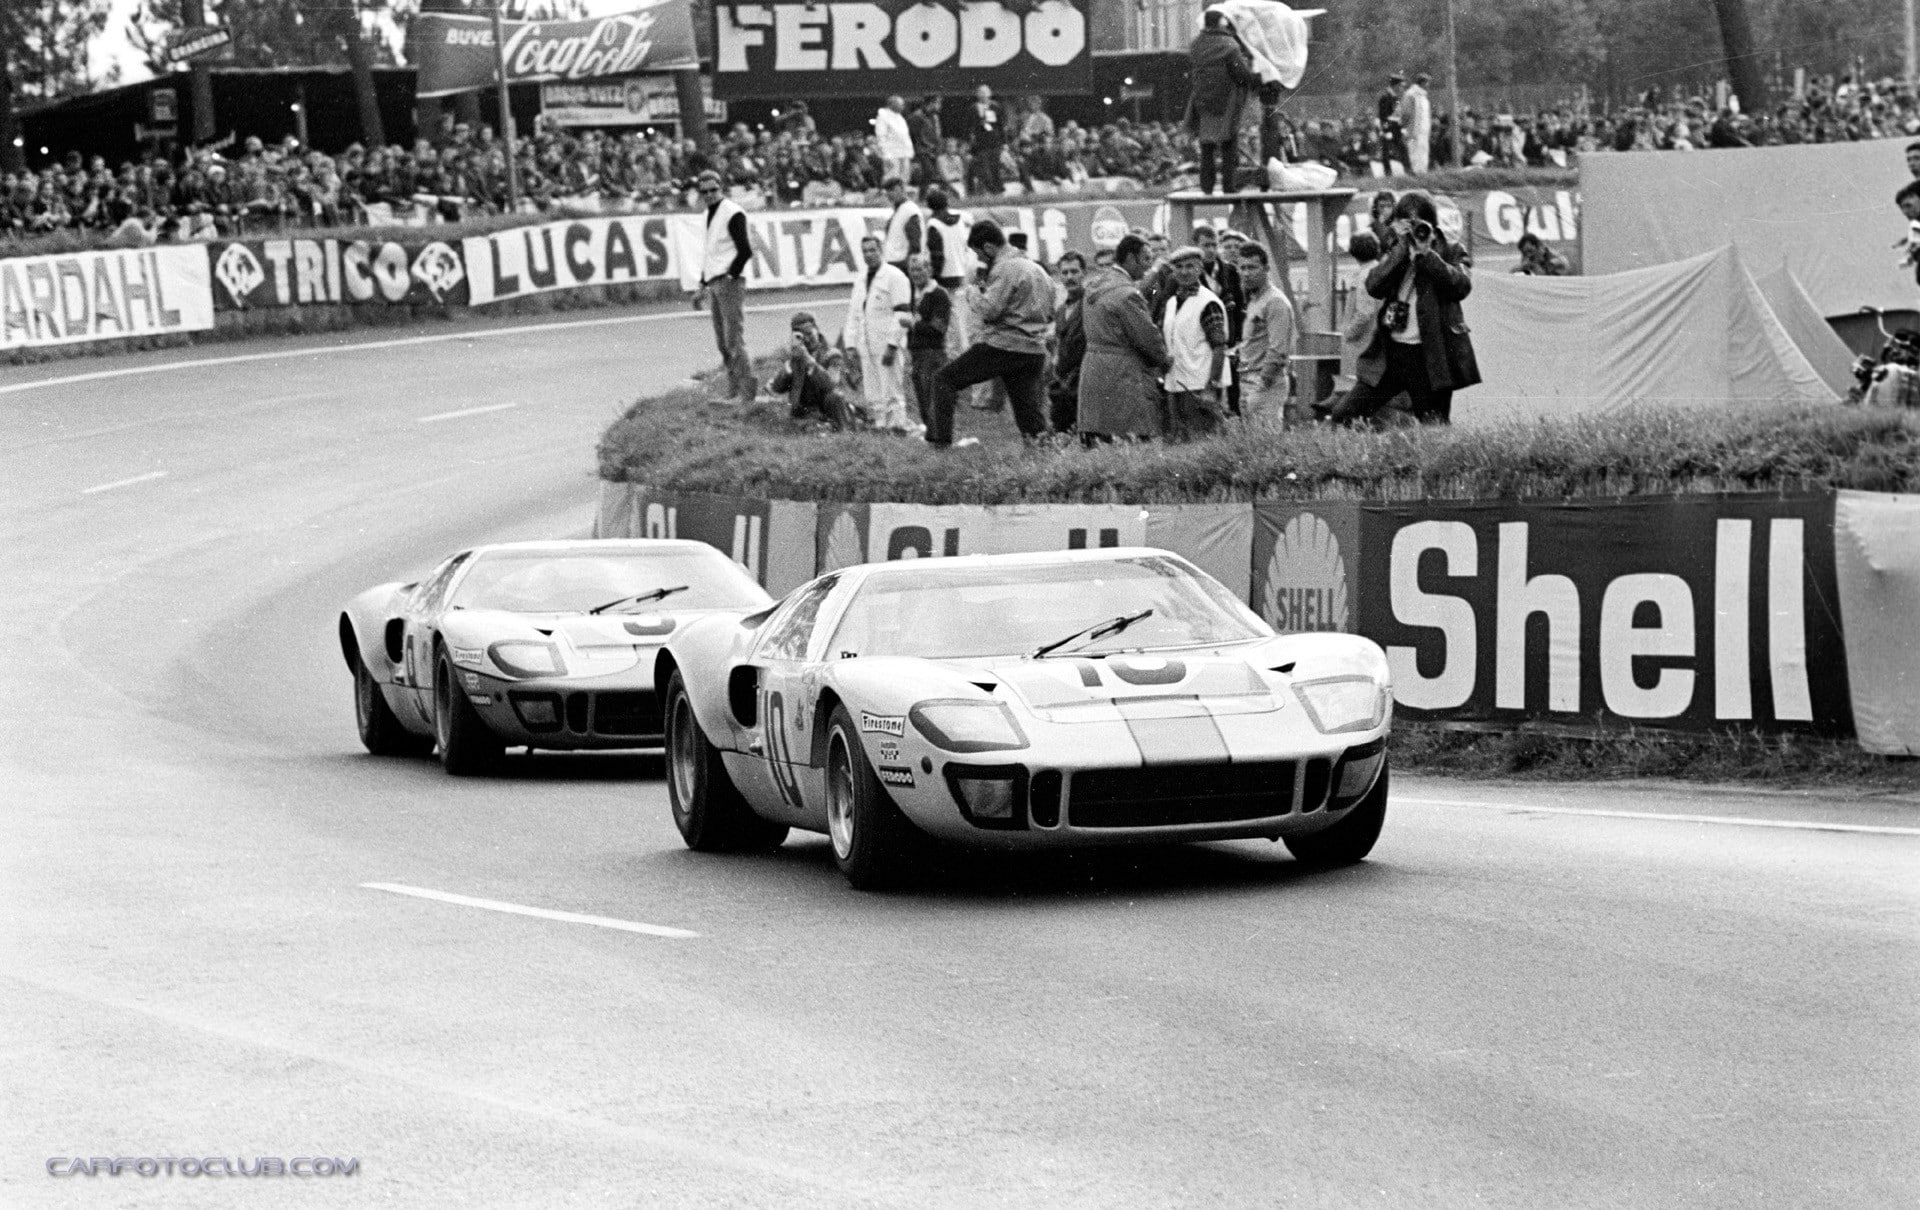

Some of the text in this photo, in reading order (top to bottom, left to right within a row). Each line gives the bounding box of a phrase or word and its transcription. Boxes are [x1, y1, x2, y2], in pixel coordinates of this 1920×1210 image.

[717, 2, 1086, 72] FERODO
[1485, 191, 1581, 244] Gul
[264, 240, 410, 303] TRICO
[489, 219, 668, 297] LUCAS
[1276, 588, 1338, 632] SHELL
[1386, 518, 1813, 720] Shell
[764, 690, 804, 808] 10
